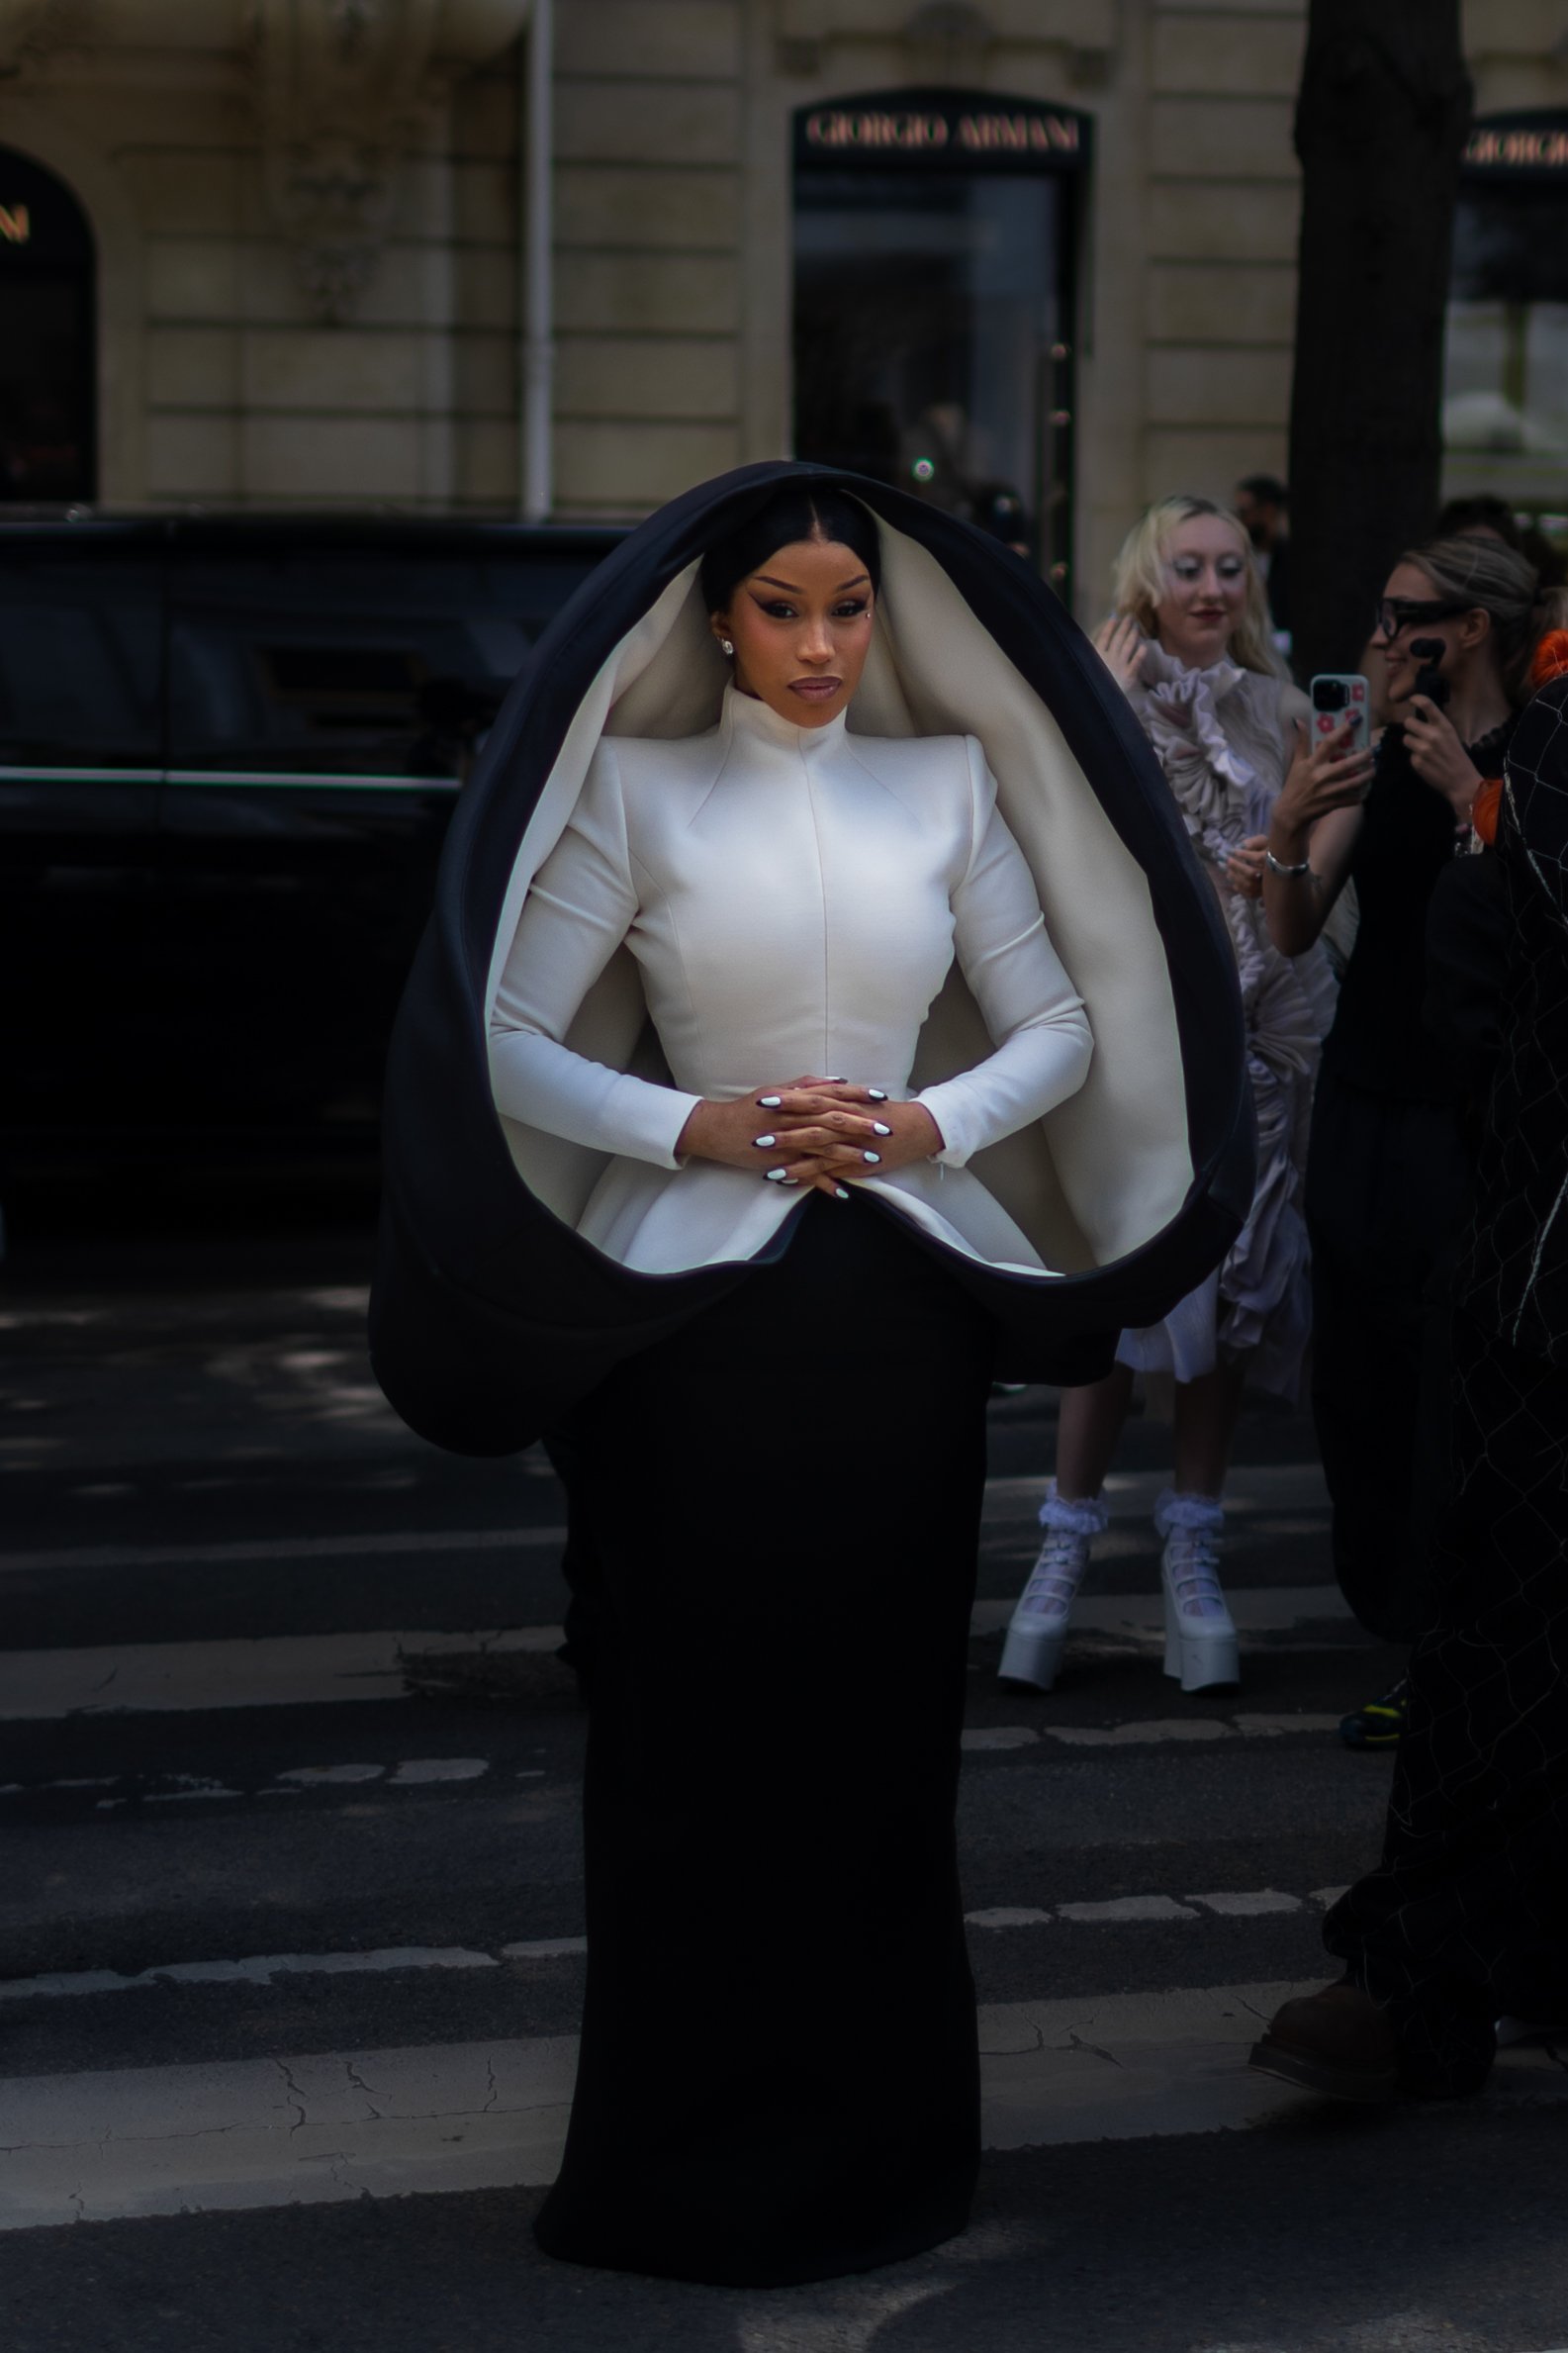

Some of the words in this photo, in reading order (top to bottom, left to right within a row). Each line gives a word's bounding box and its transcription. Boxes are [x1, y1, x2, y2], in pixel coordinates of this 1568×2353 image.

[806, 111, 949, 147] GIORGIO
[955, 114, 1079, 151] ARMANI
[1461, 130, 1568, 166] GIORGI
